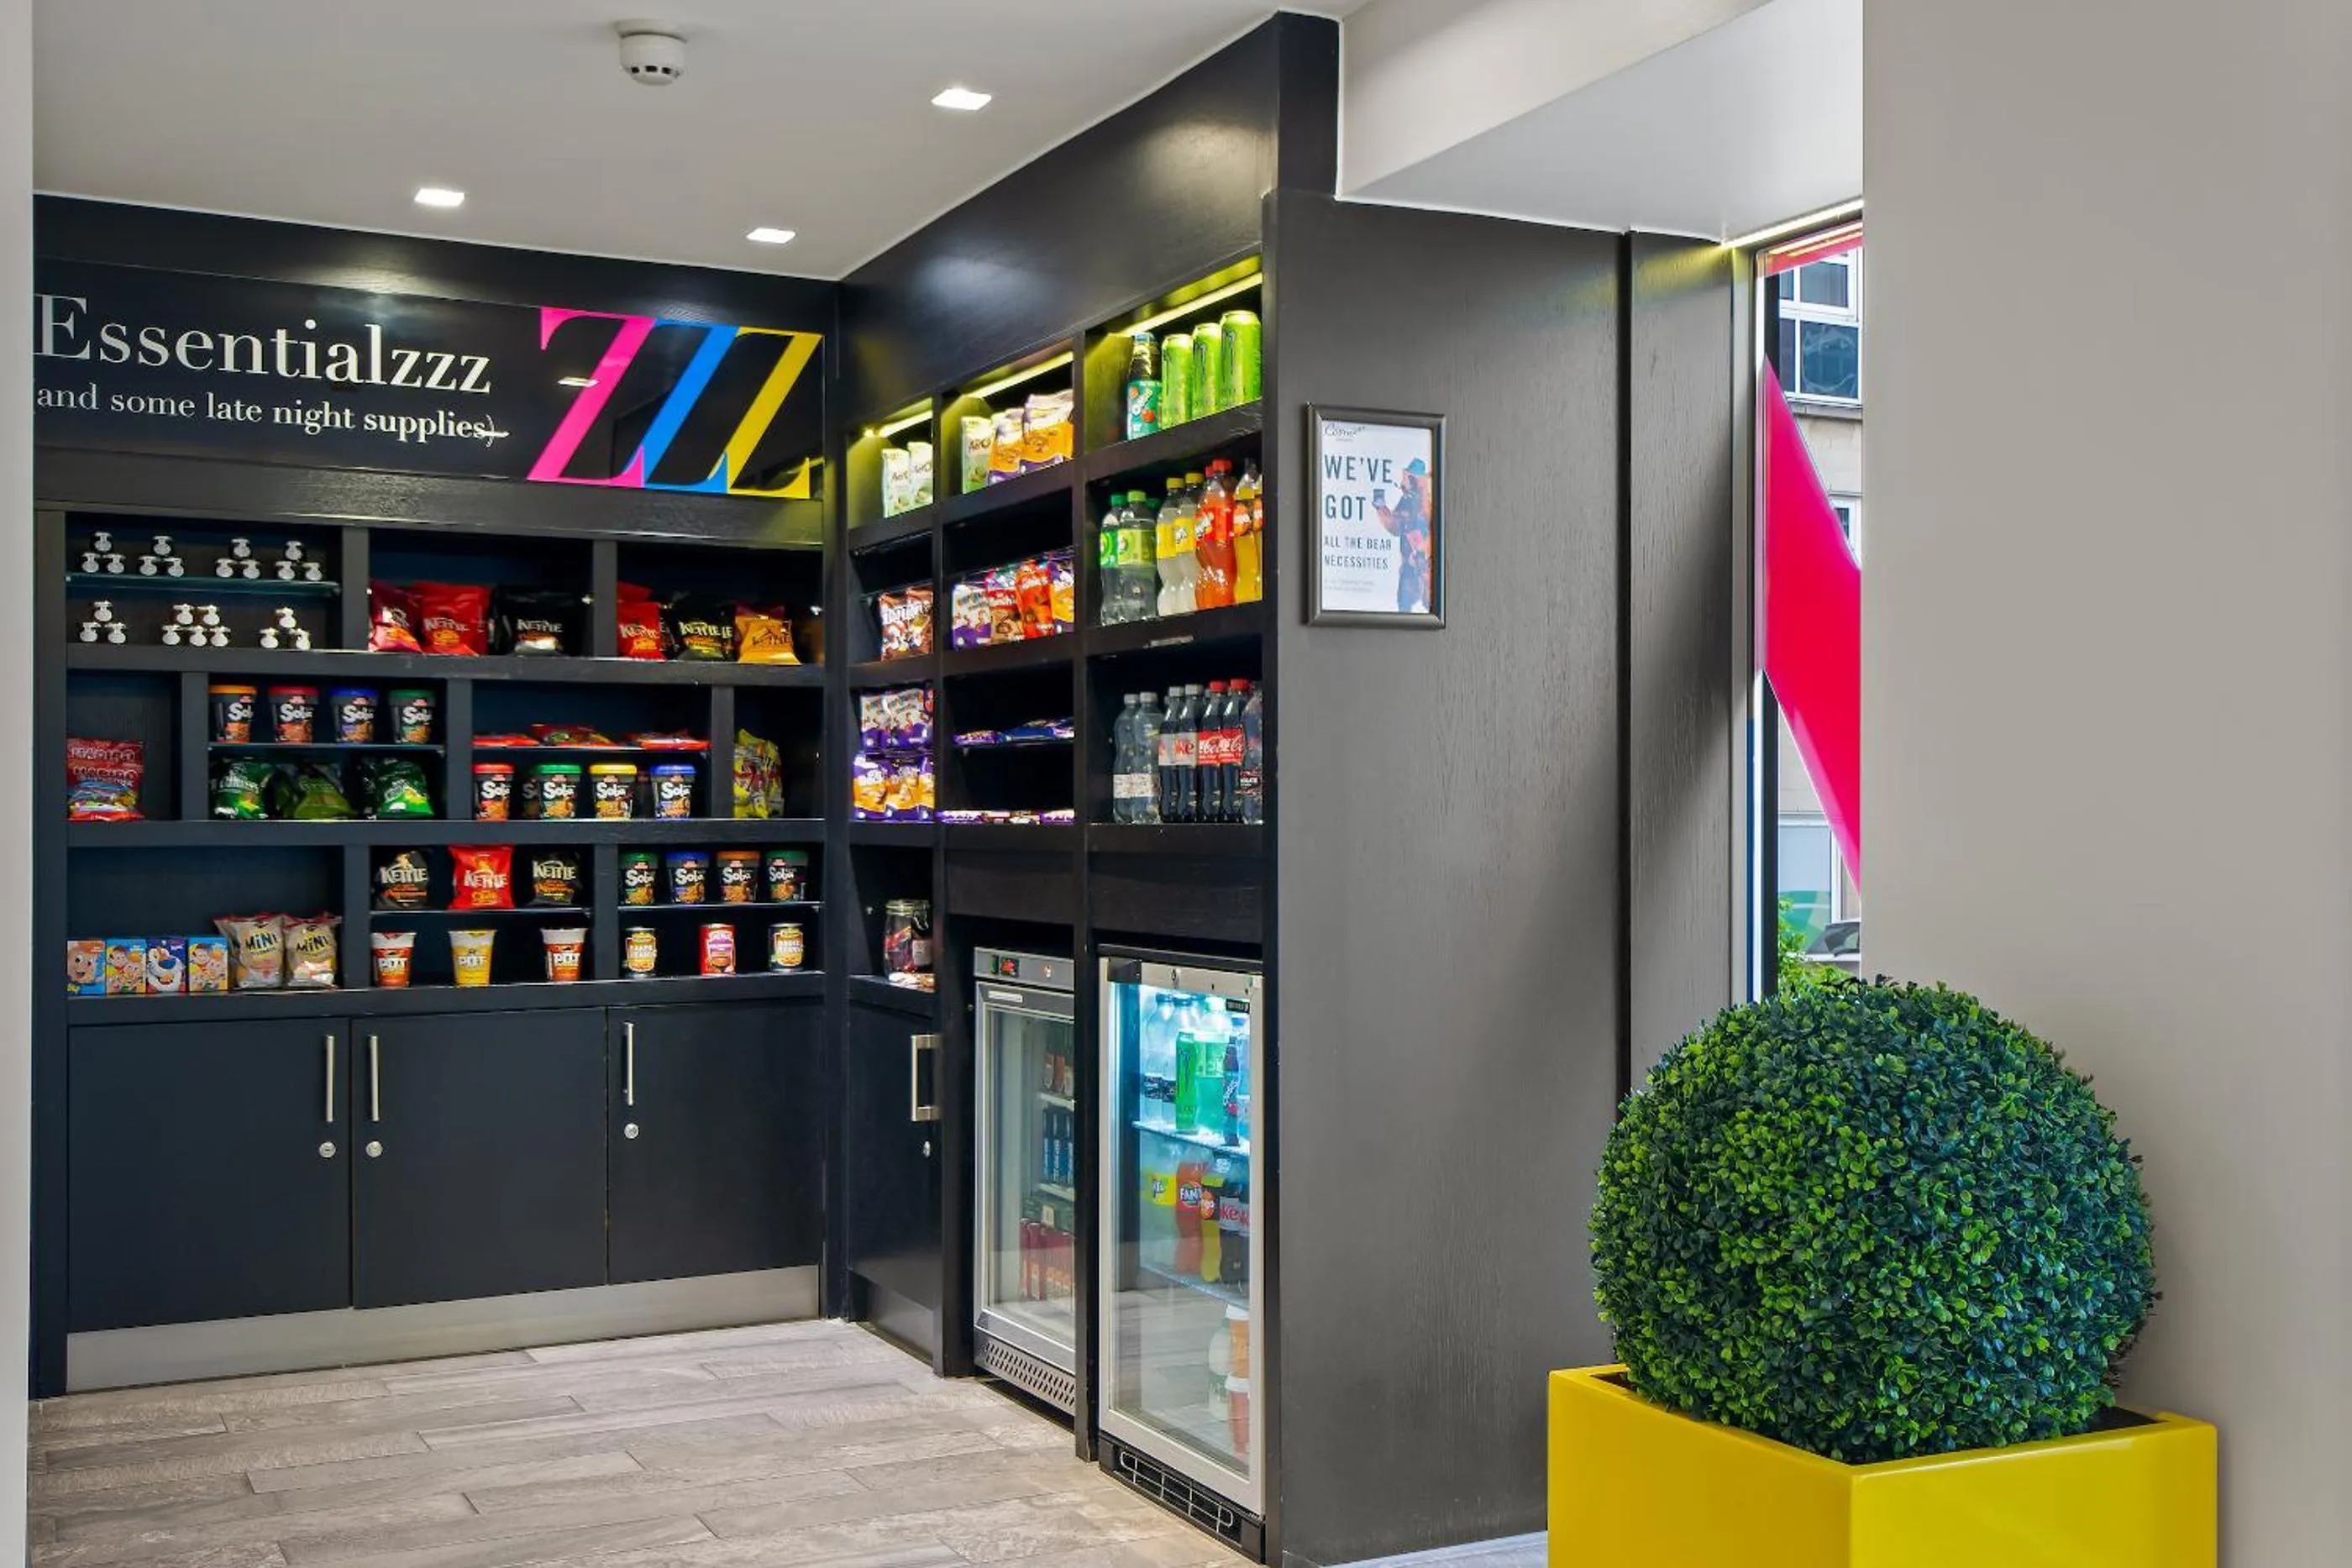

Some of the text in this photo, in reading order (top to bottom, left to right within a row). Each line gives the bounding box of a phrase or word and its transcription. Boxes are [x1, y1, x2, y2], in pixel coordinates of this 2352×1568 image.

[33, 293, 491, 394] Essentialzzz
[111, 388, 196, 417] some
[206, 391, 263, 422] late
[273, 399, 355, 434] night
[1324, 454, 1394, 484] WE'VE
[1324, 494, 1367, 522] GOT
[1324, 535, 1392, 551] ALL THE BEAR
[1324, 554, 1389, 571] NECESSITIES
[380, 863, 428, 884] KETTLE
[532, 860, 577, 880] KETTLE
[722, 866, 752, 883] Soba
